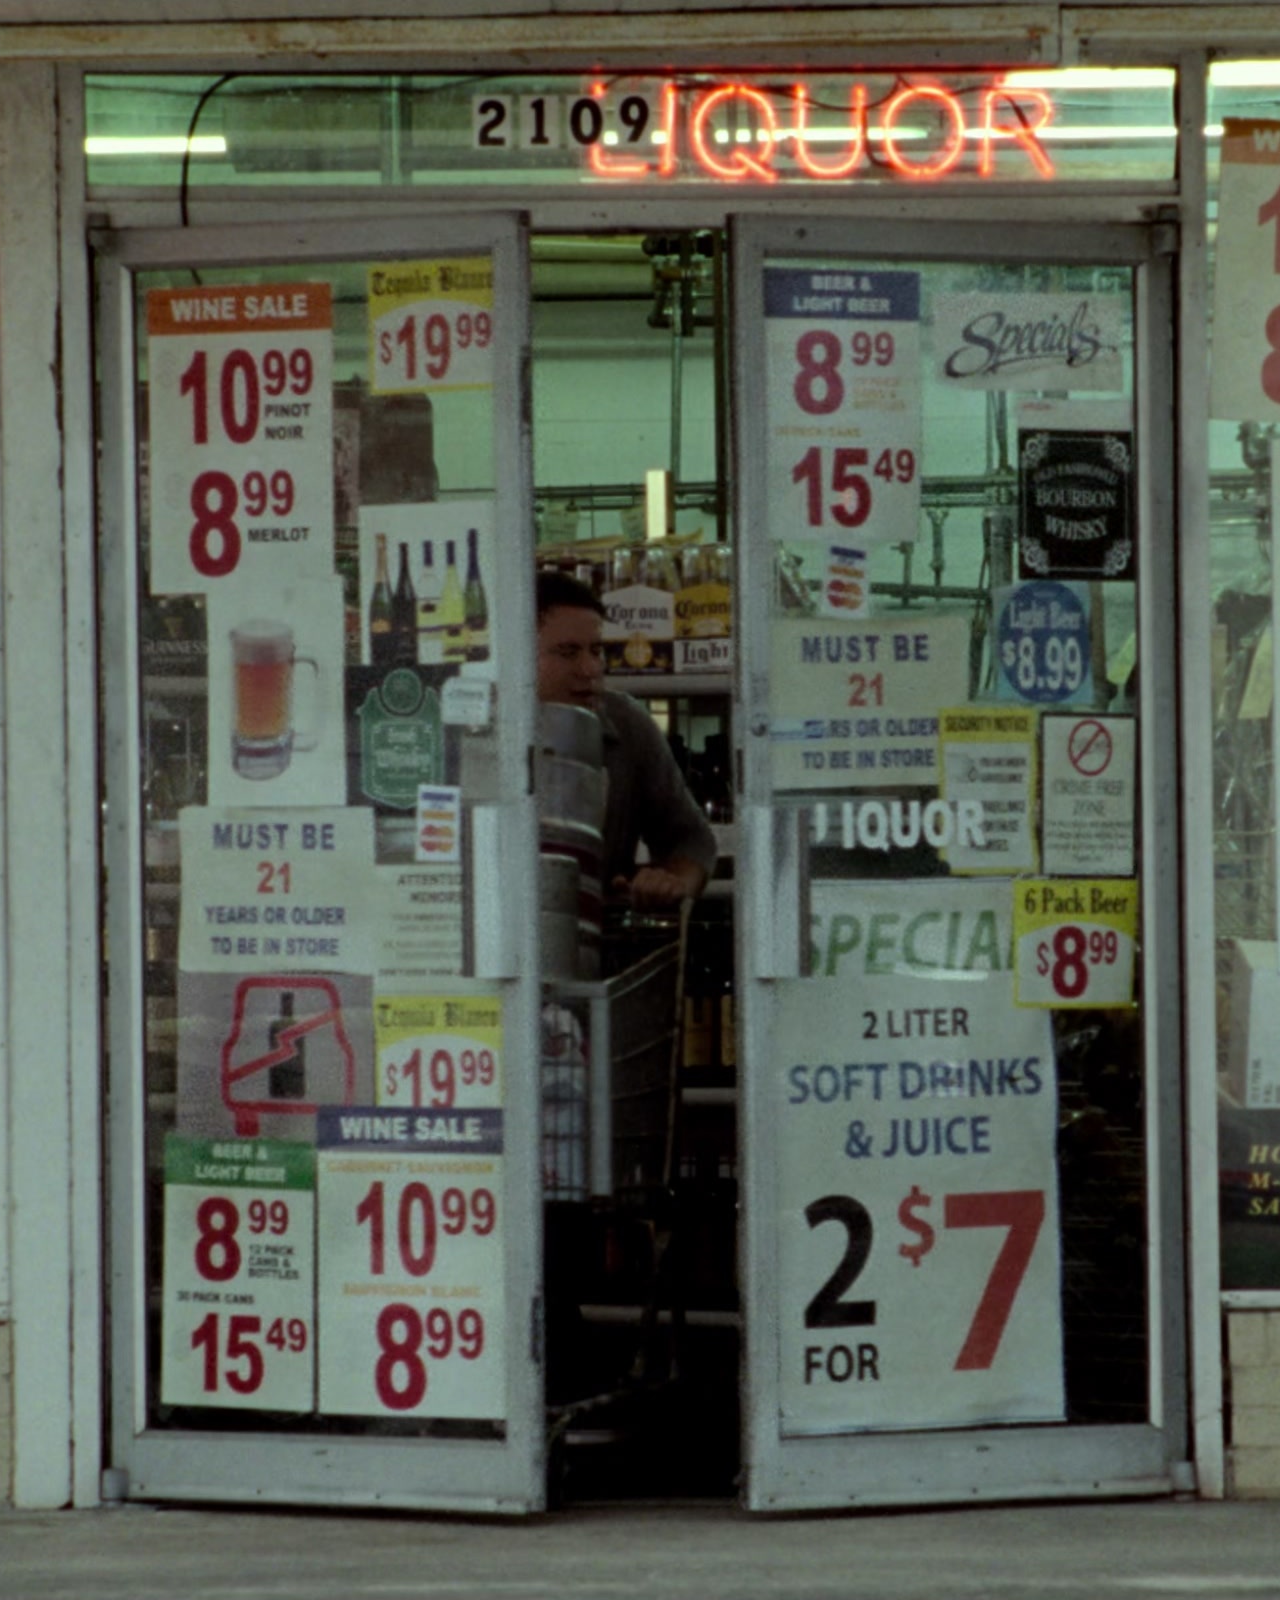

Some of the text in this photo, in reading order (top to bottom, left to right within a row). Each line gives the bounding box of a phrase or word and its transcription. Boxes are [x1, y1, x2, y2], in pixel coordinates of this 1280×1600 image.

[477, 95, 650, 147] 2109
[591, 82, 1055, 180] LIQUOR
[170, 294, 308, 322] WINE SALE
[944, 301, 1118, 379] Specials
[264, 402, 311, 418] PINOT
[264, 425, 303, 441] NOIR
[1036, 488, 1116, 508] BOURBON
[247, 527, 310, 543] MERLOT
[1045, 513, 1109, 541] WHISKY
[1008, 602, 1082, 630] Light Beer
[801, 633, 931, 663] MUST BE
[847, 673, 884, 707] 21
[213, 823, 336, 851] MUST BE
[256, 861, 292, 894] 21
[1040, 887, 1129, 914] Pack Beer
[204, 905, 346, 926] YEARS OR OLDER
[210, 936, 340, 956] TO BE IN STORE
[862, 1007, 969, 1039] 2 LITER
[788, 1057, 1042, 1104] SOFT DRINKS
[844, 1116, 991, 1158] & JUICE
[804, 1194, 877, 1329] 2
[803, 1343, 880, 1385] FOR
